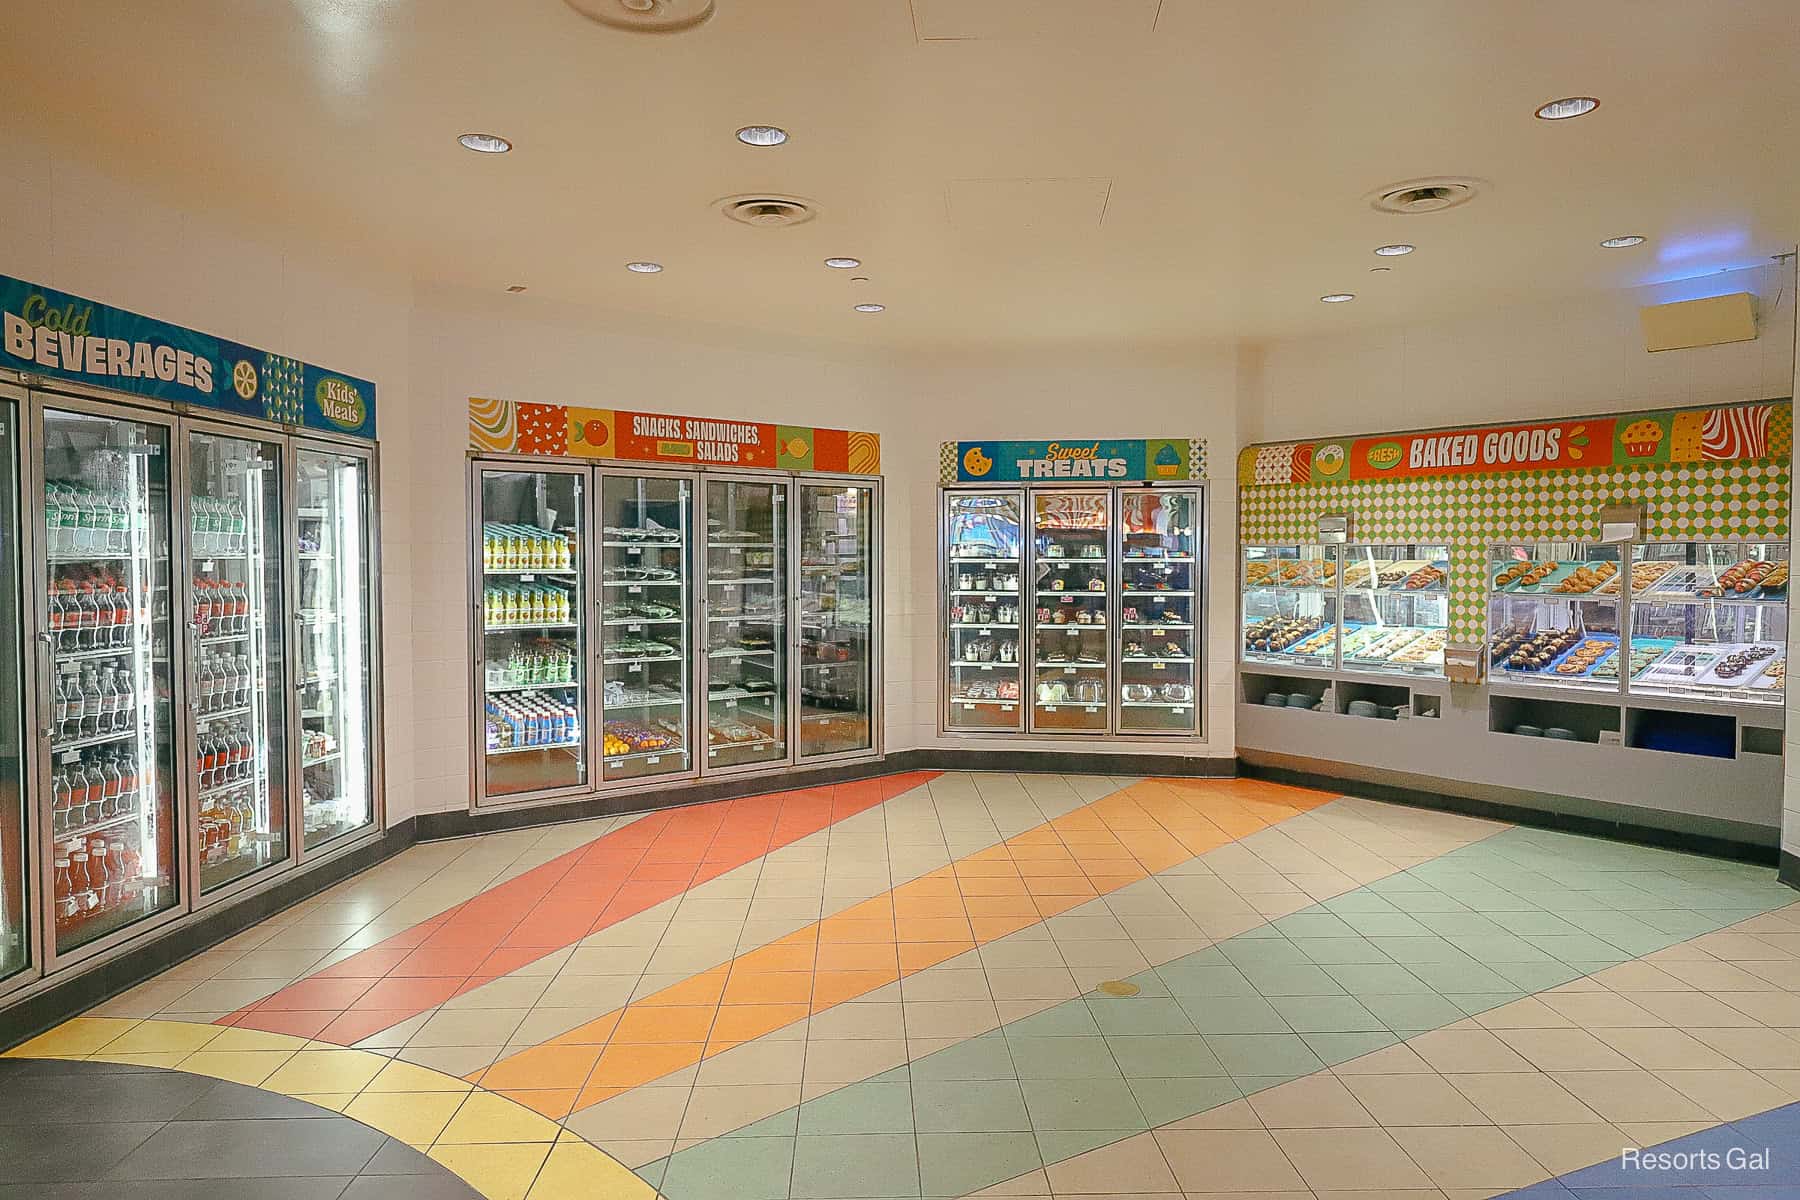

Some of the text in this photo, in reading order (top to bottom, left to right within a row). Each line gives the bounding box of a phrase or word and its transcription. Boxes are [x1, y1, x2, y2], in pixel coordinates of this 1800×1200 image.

[23, 294, 92, 337] Cold
[4, 311, 214, 393] BEVERAGES
[327, 381, 357, 404] Kids'
[323, 398, 358, 423] Meals
[633, 415, 761, 447] SNACKS, SANDWICHES,
[697, 441, 739, 462] SALADS
[1045, 441, 1100, 461] Sweet
[1368, 447, 1400, 462] FRESH
[1409, 428, 1562, 469] BAKED GOODS
[1016, 458, 1128, 478] TREATS
